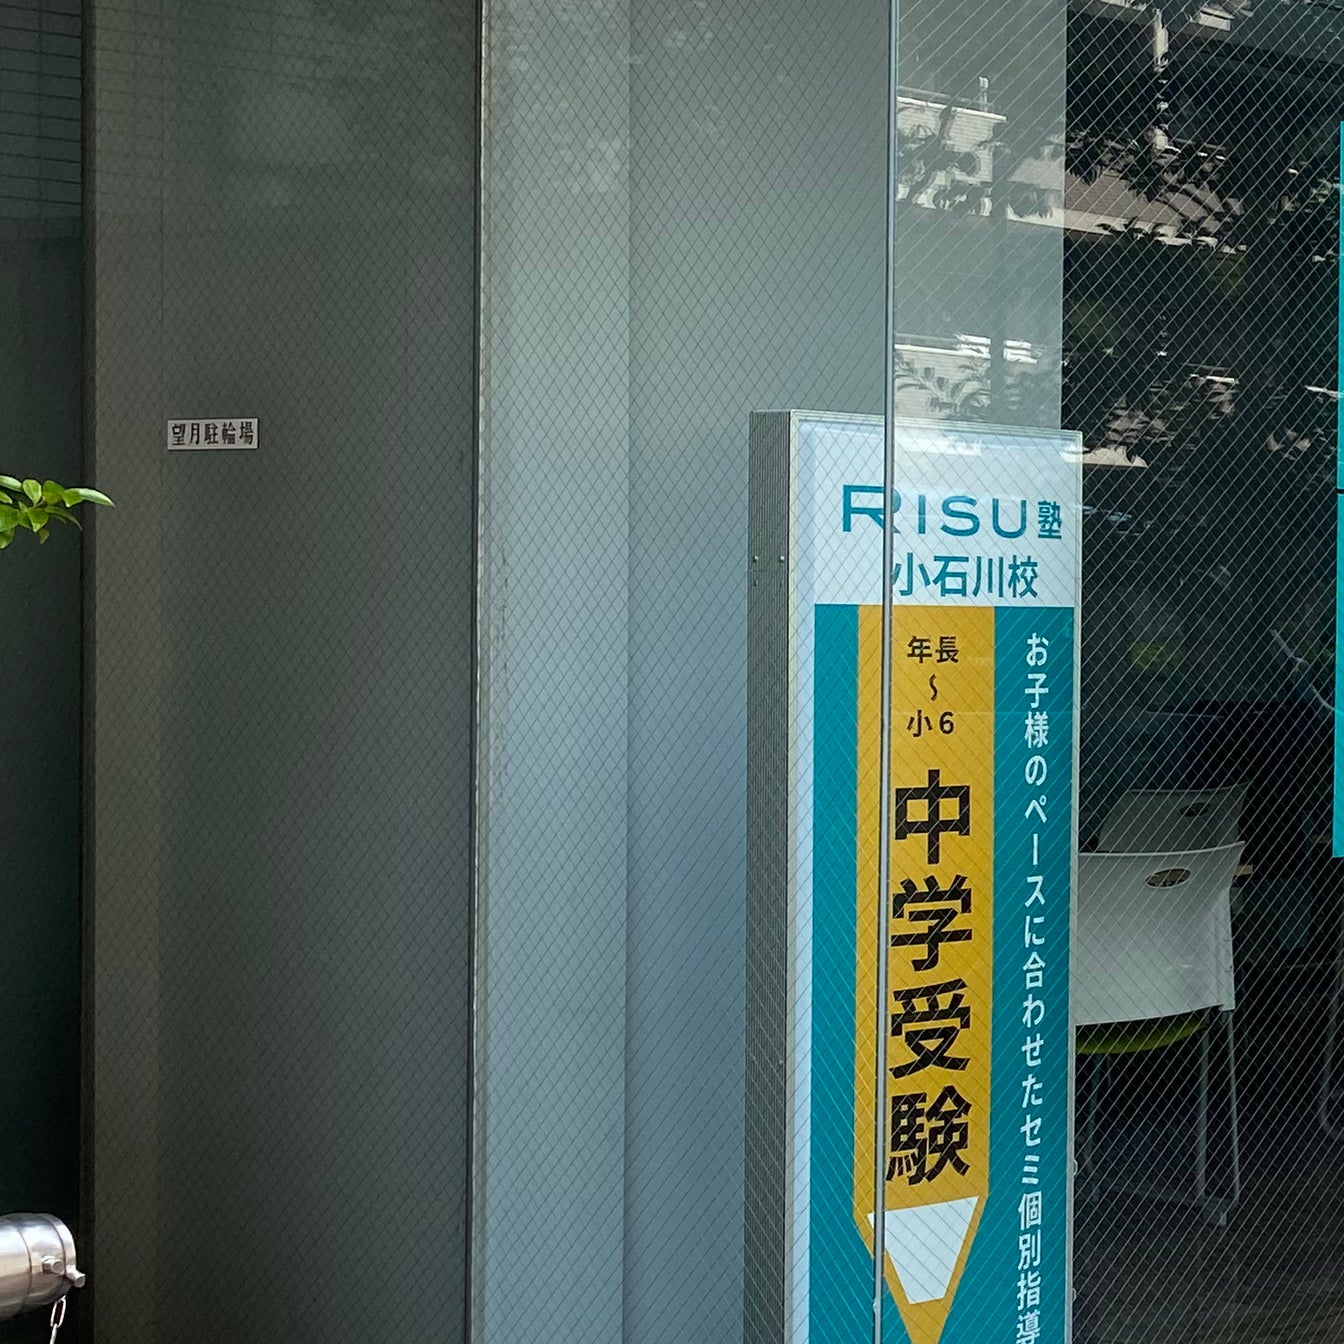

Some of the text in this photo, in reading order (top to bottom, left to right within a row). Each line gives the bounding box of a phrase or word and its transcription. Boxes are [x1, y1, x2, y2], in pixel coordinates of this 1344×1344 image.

[171, 421, 254, 446] 望月駐輪場
[842, 484, 1063, 540] RISU塾
[894, 552, 1040, 599] 小石川校
[907, 635, 960, 664] 年長
[906, 711, 955, 739] 小6
[885, 768, 974, 1186] 中学受験
[1016, 632, 1050, 1344] お子様のペースに合わせたセミ個別指導
